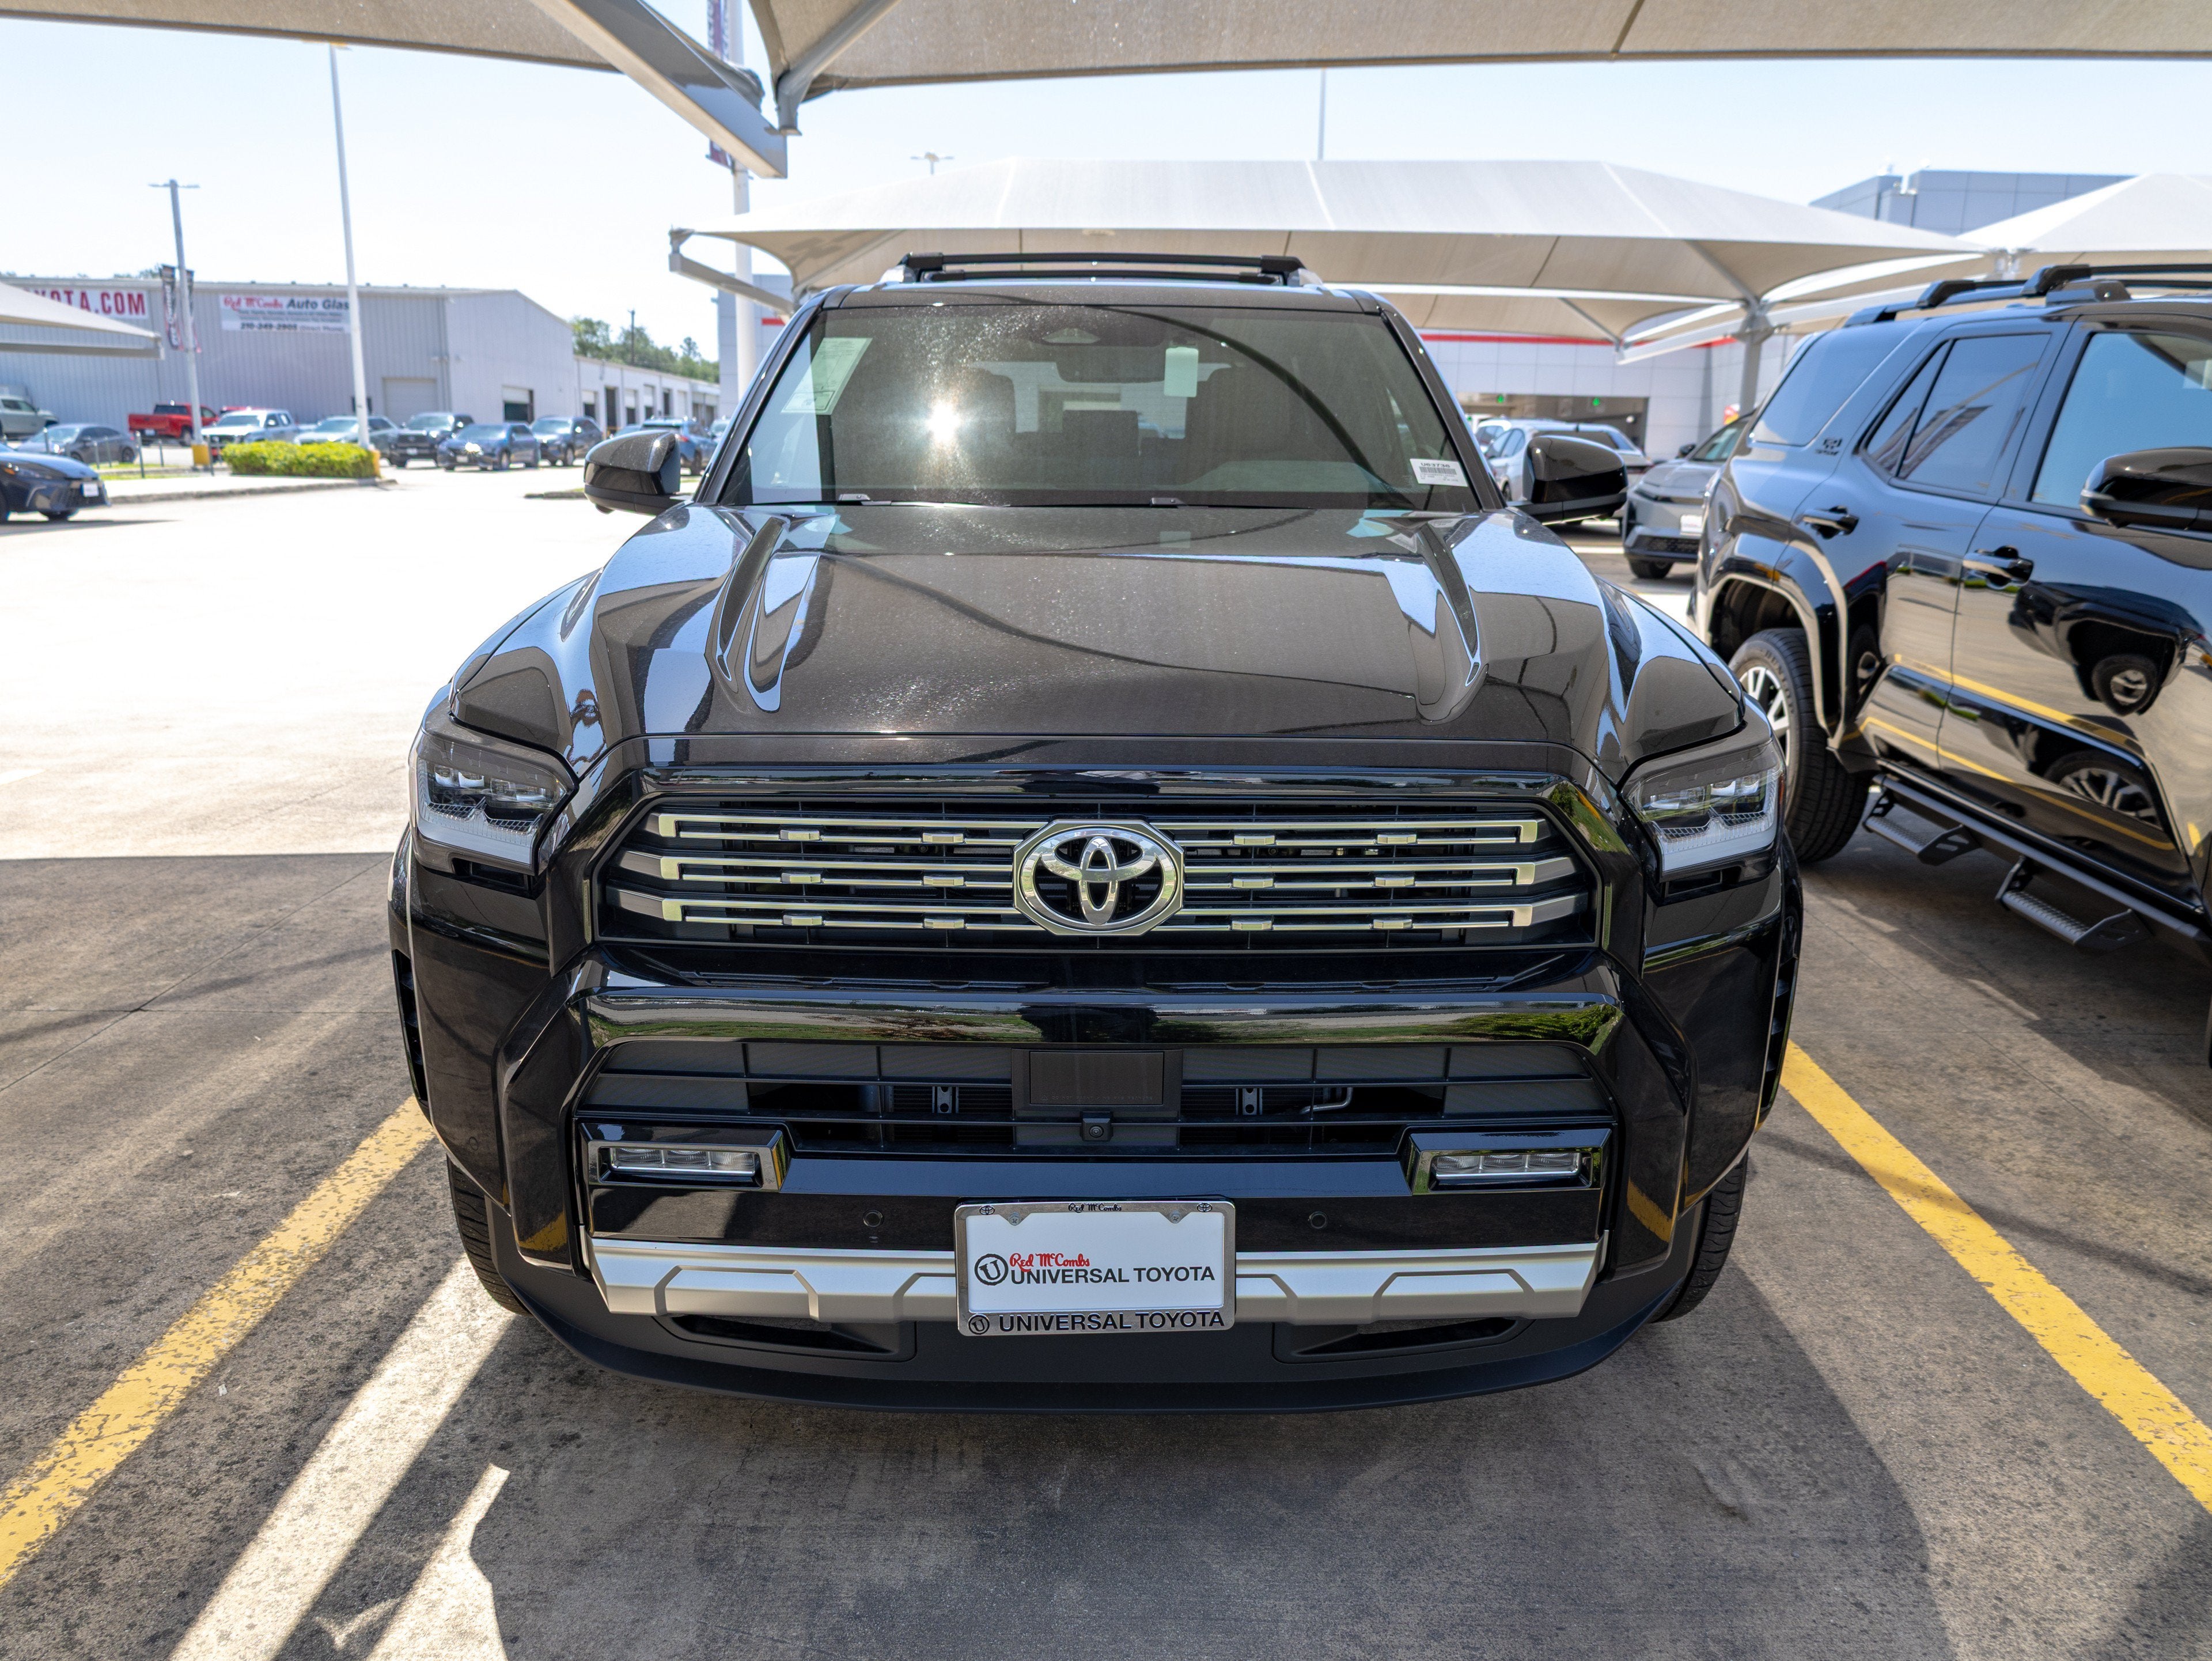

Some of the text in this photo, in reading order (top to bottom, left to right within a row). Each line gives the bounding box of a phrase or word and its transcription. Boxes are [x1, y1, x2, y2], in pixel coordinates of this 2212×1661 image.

[287, 298, 318, 309] Auto
[1067, 1202, 1122, 1213] Red McCombs
[1009, 1253, 1090, 1273] Red McCombs
[1011, 1267, 1130, 1285] UNIVERSAL
[1133, 1266, 1215, 1282] TOYOTA
[999, 1312, 1132, 1332] UNIVERSAL
[1135, 1310, 1225, 1329] TOYOTA
